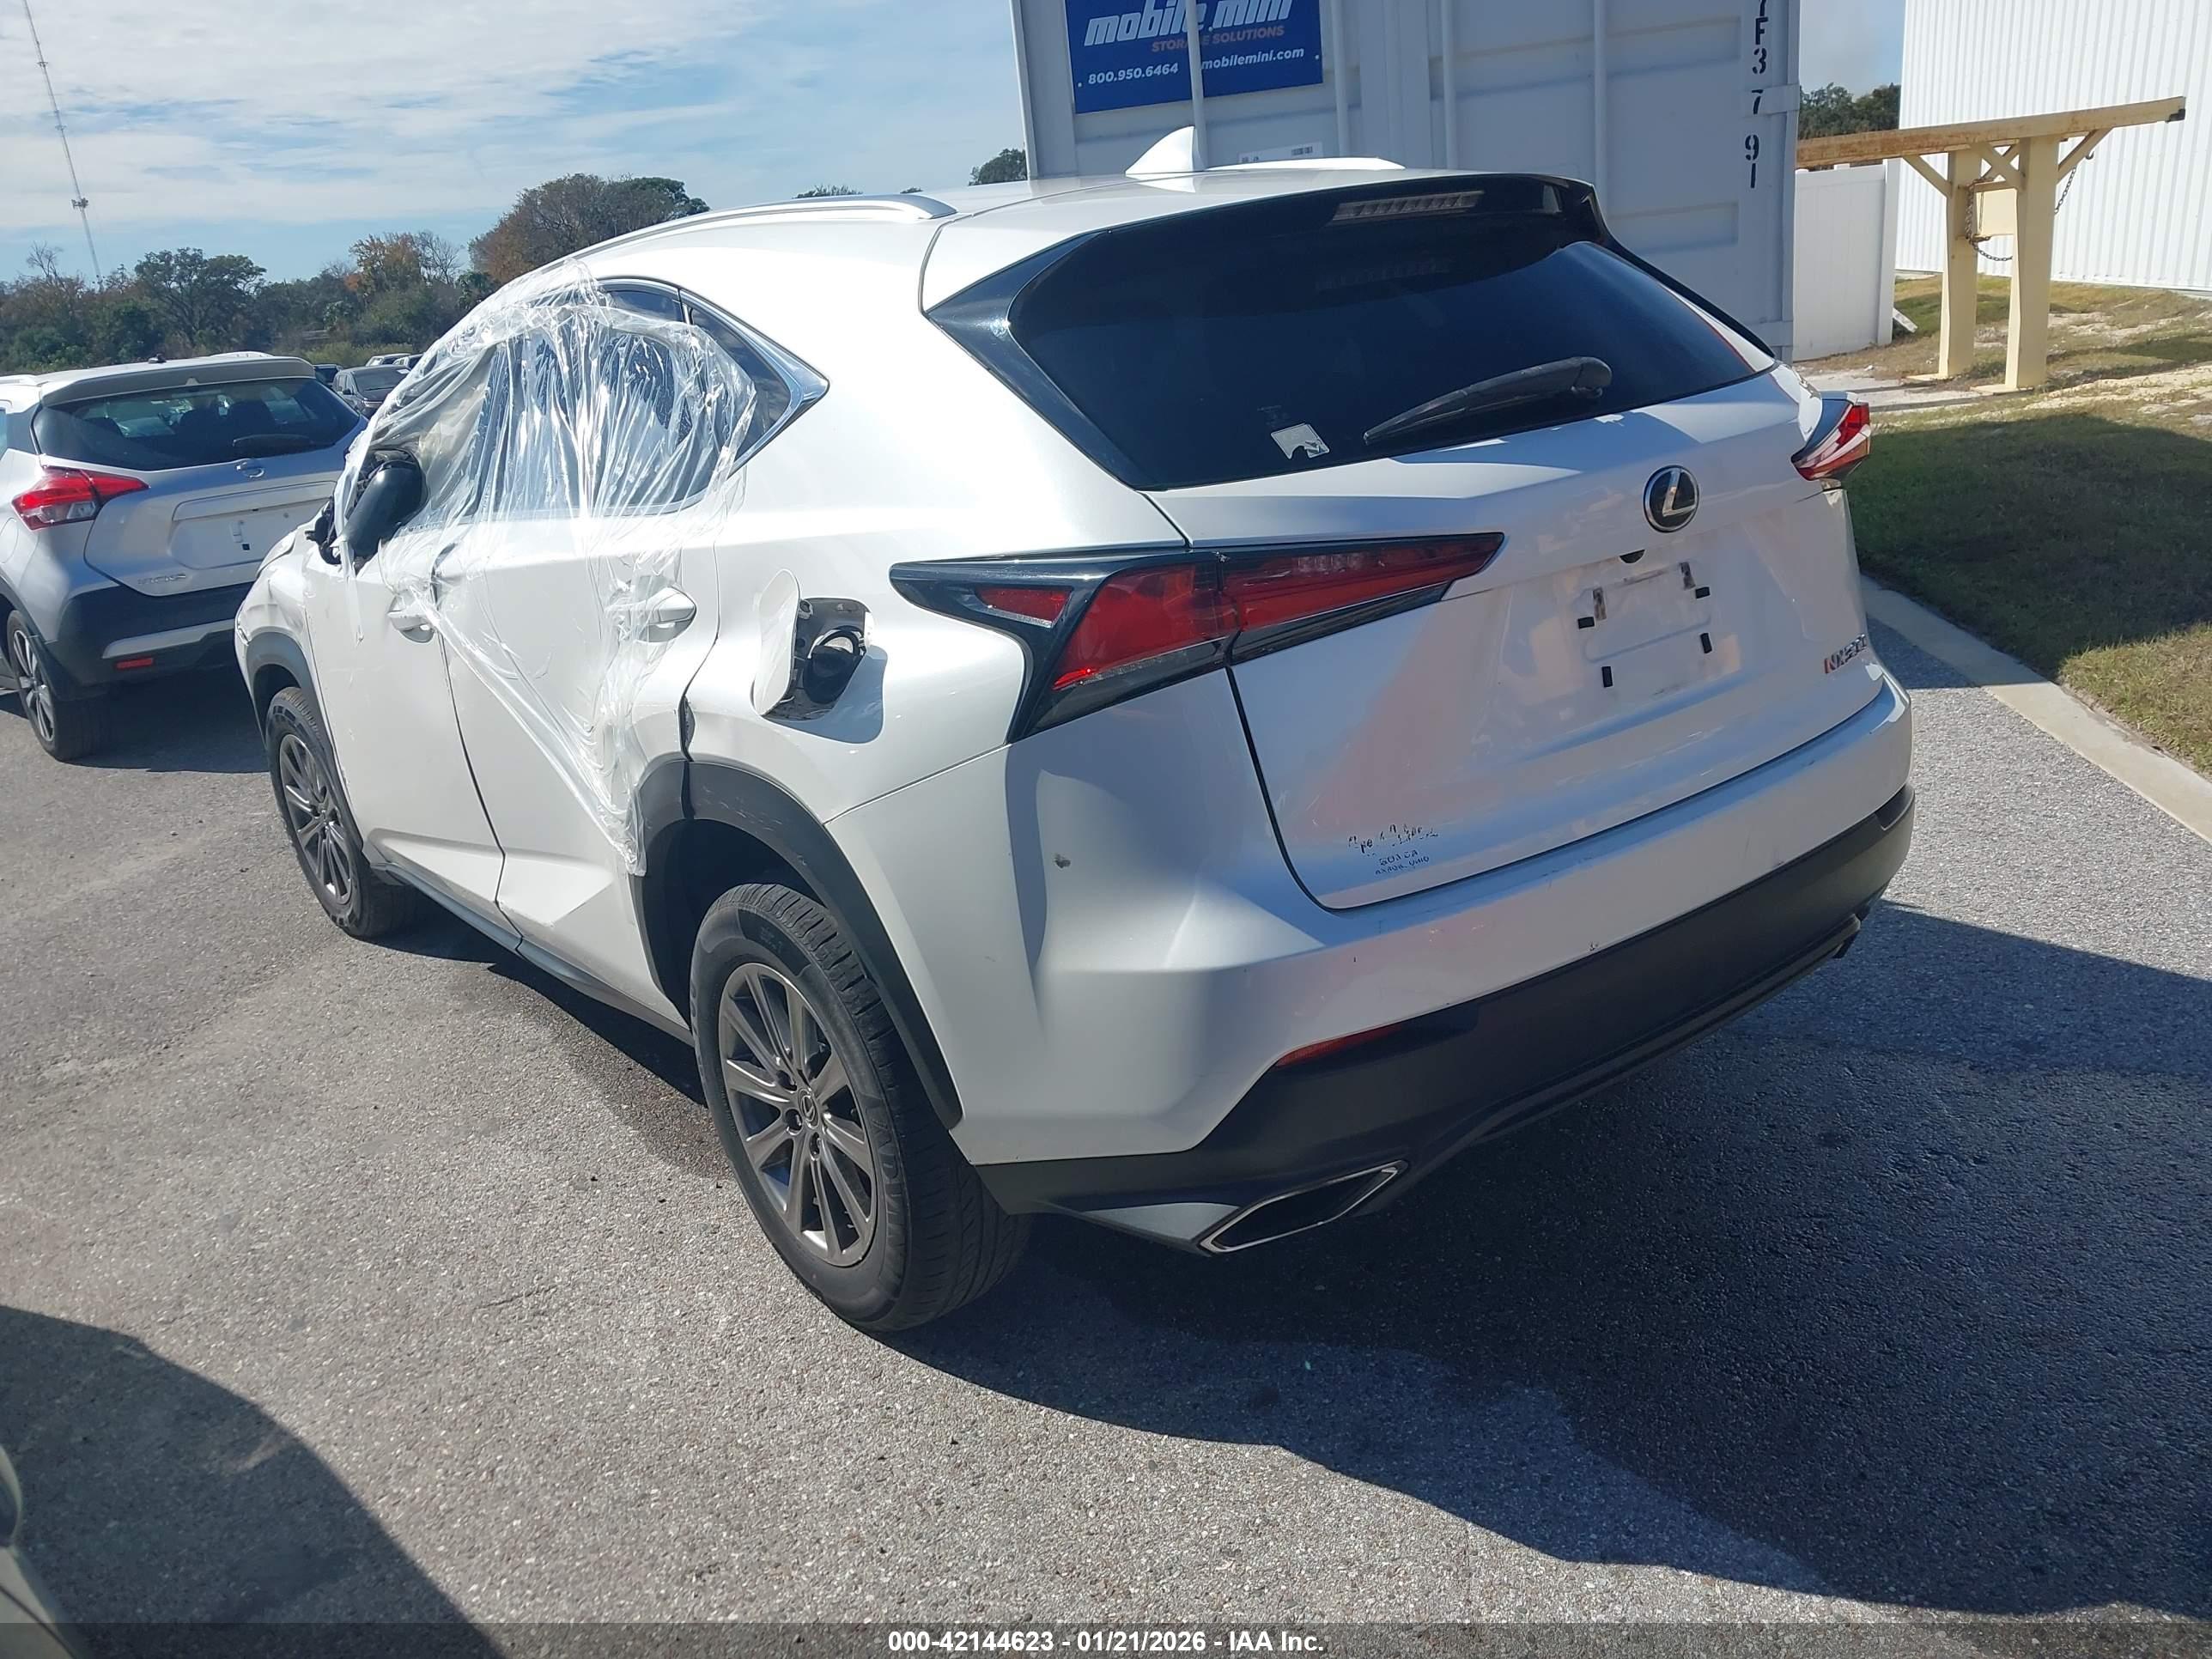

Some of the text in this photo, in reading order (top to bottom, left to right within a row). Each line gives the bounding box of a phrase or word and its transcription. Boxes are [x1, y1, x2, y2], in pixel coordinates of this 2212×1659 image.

[1212, 25, 1285, 45] SOLUTIONS
[1201, 48, 1304, 69] mobilemini.com
[1088, 63, 1179, 84] 800.950.6464
